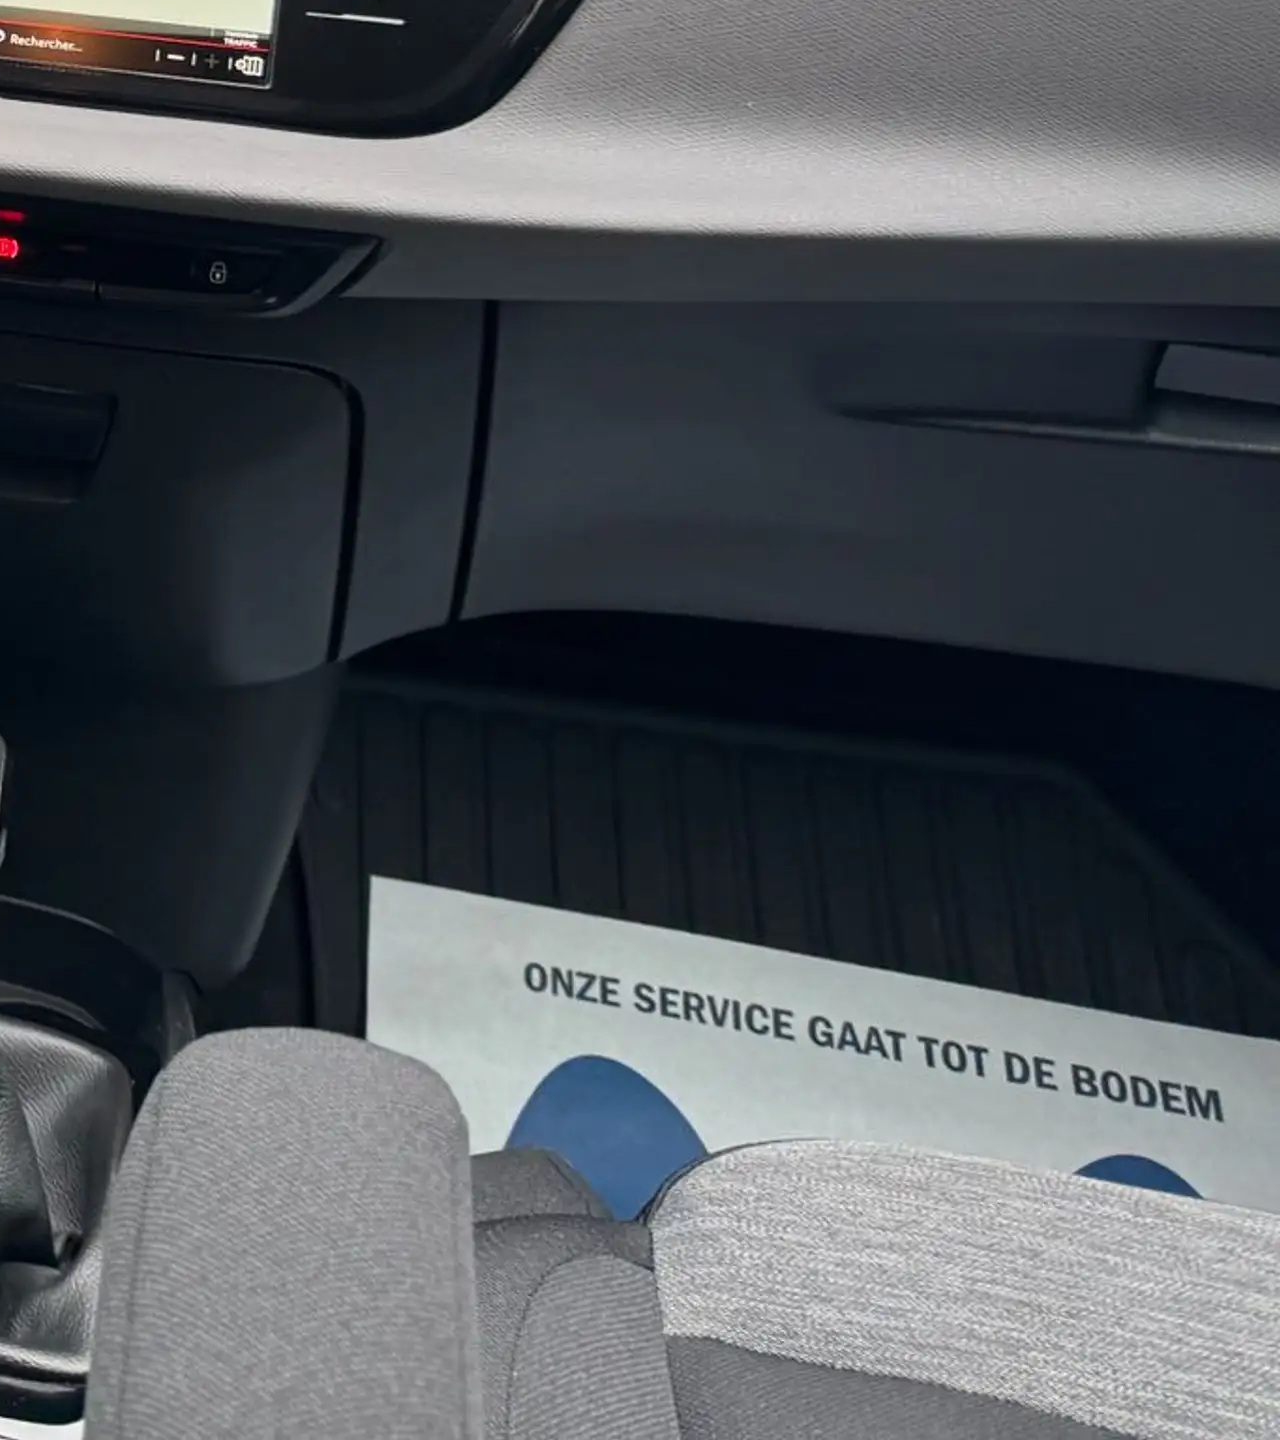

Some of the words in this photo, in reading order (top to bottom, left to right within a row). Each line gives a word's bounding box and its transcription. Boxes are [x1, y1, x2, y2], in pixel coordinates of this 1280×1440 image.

[524, 962, 621, 1008] ONZE
[634, 983, 795, 1041] SERVICE
[808, 1016, 907, 1062] GAAT
[917, 1036, 989, 1078] TOT
[1003, 1051, 1059, 1091] DE
[1071, 1063, 1225, 1123] BODEM
